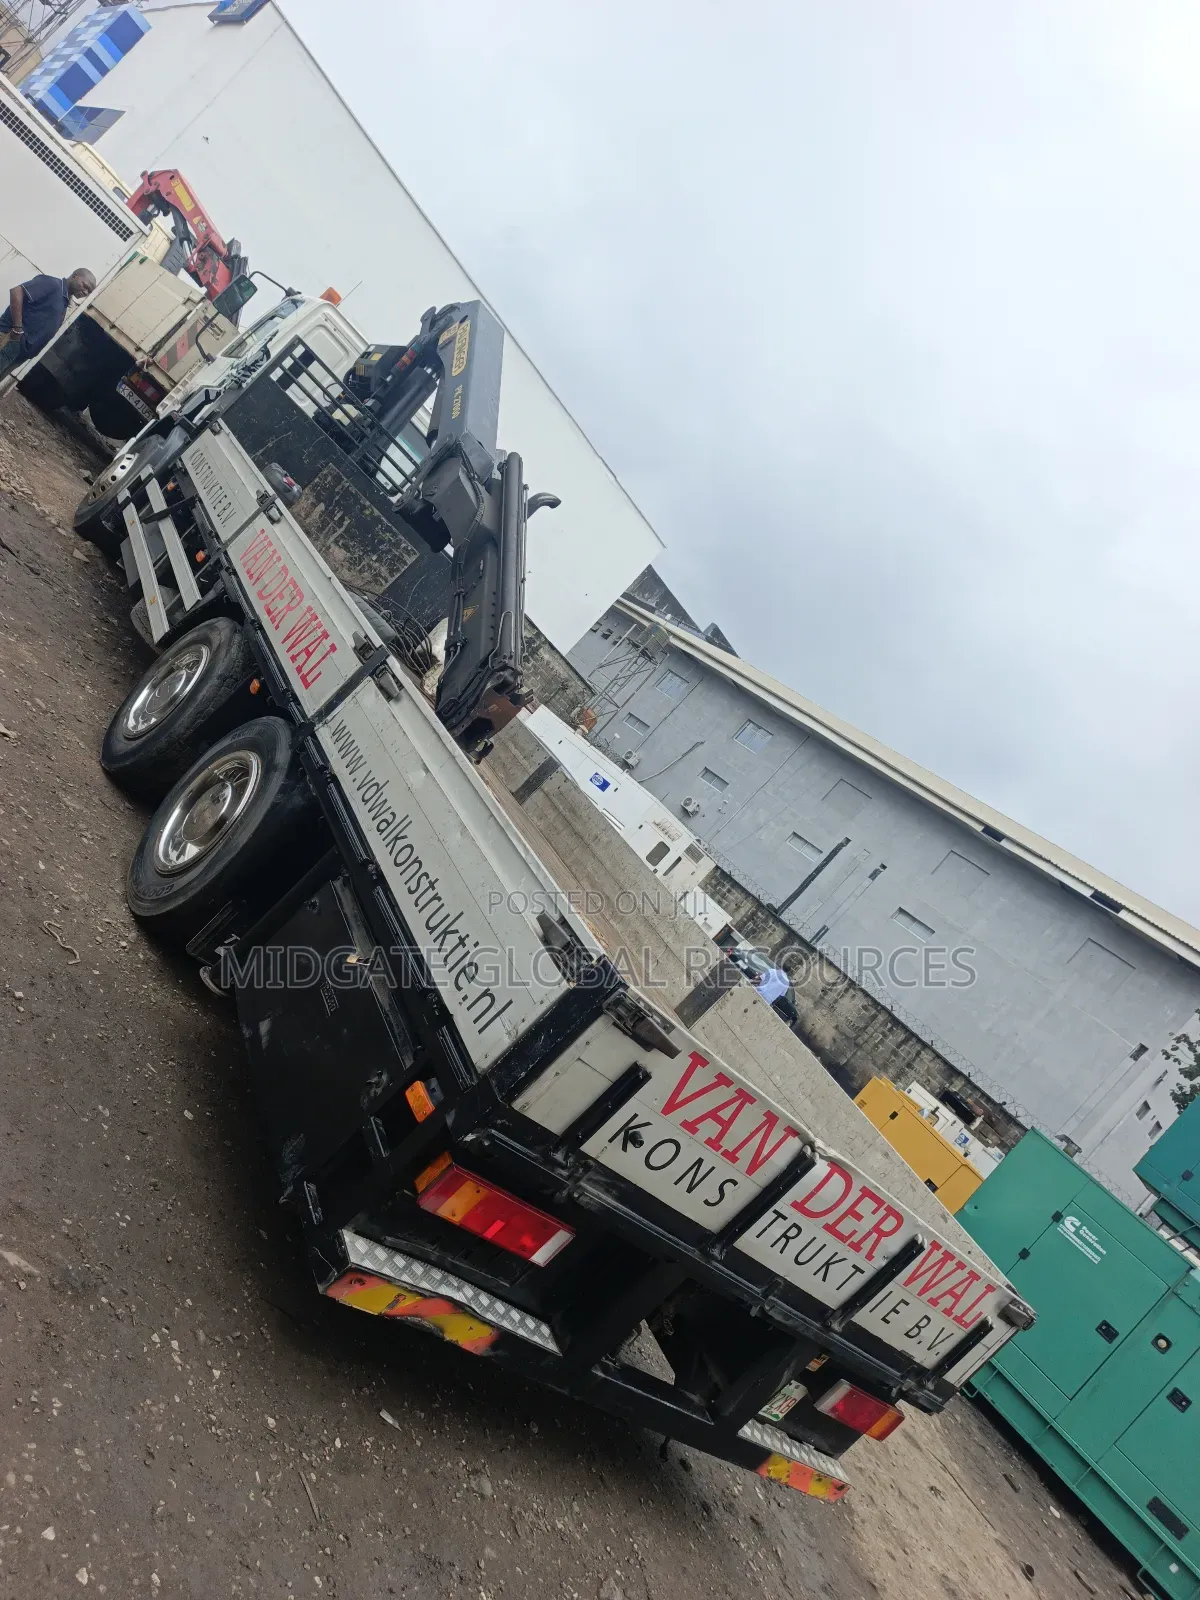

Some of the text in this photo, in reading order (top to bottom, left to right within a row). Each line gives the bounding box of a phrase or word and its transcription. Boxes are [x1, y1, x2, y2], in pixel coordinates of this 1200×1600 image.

[119, 385, 134, 401] KR
[187, 447, 229, 515] KONSTRUKTIE
[239, 528, 338, 690] VAN DER WAL
[331, 718, 514, 1035] www.vdwalkonstruktie.nl
[660, 1050, 997, 1330] VAN DER WAL
[1079, 1229, 1107, 1255] Generation
[1081, 1225, 1099, 1241] Power
